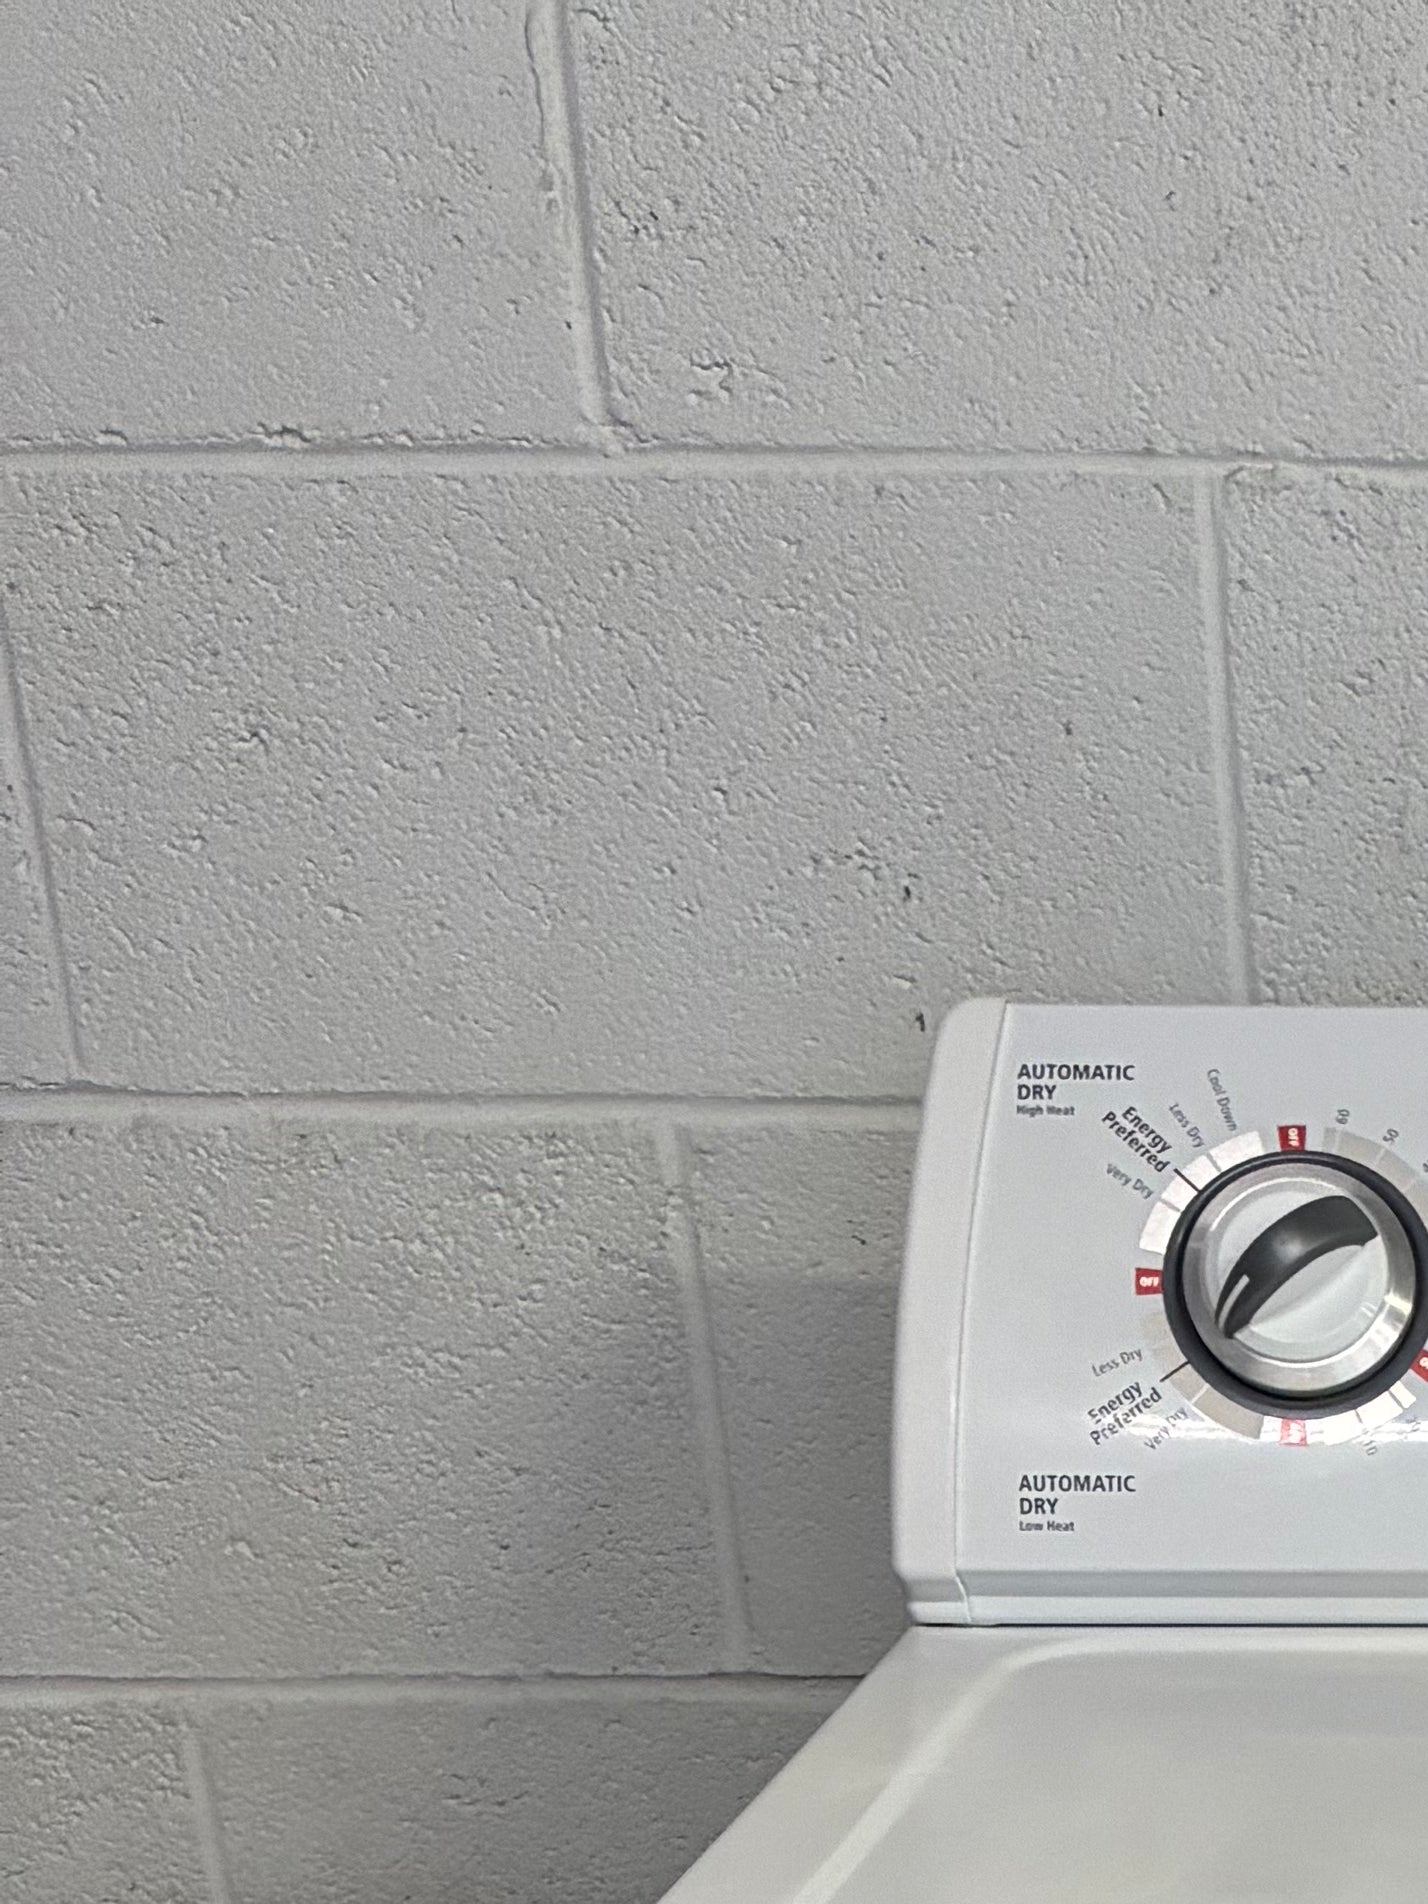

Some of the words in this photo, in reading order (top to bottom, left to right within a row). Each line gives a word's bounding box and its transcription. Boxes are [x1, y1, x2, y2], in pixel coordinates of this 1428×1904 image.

[1016, 1064, 1136, 1081] AUTOMATIC
[1016, 1084, 1057, 1100] DRY
[1206, 1068, 1223, 1097] Cool
[1216, 1097, 1238, 1132] Down
[1016, 1105, 1044, 1118] High
[1046, 1105, 1075, 1116] Heat
[1121, 1106, 1172, 1154] Energy
[1169, 1103, 1188, 1129] Less
[1186, 1126, 1205, 1149] Dry
[1382, 1128, 1400, 1144] 50
[1101, 1110, 1171, 1173] Preferred
[1288, 1127, 1300, 1147] OFF
[1106, 1164, 1130, 1187] Very
[1132, 1178, 1155, 1200] Dry
[1139, 1276, 1160, 1288] OFF
[1091, 1360, 1120, 1377] Less
[1119, 1348, 1144, 1367] Dry
[1087, 1380, 1143, 1424] Energy
[1090, 1386, 1163, 1446] Preferred
[1018, 1474, 1137, 1493] AUTOMATIC
[1018, 1497, 1059, 1515] DRY
[1018, 1520, 1043, 1532] Low
[1046, 1520, 1075, 1532] Heat
